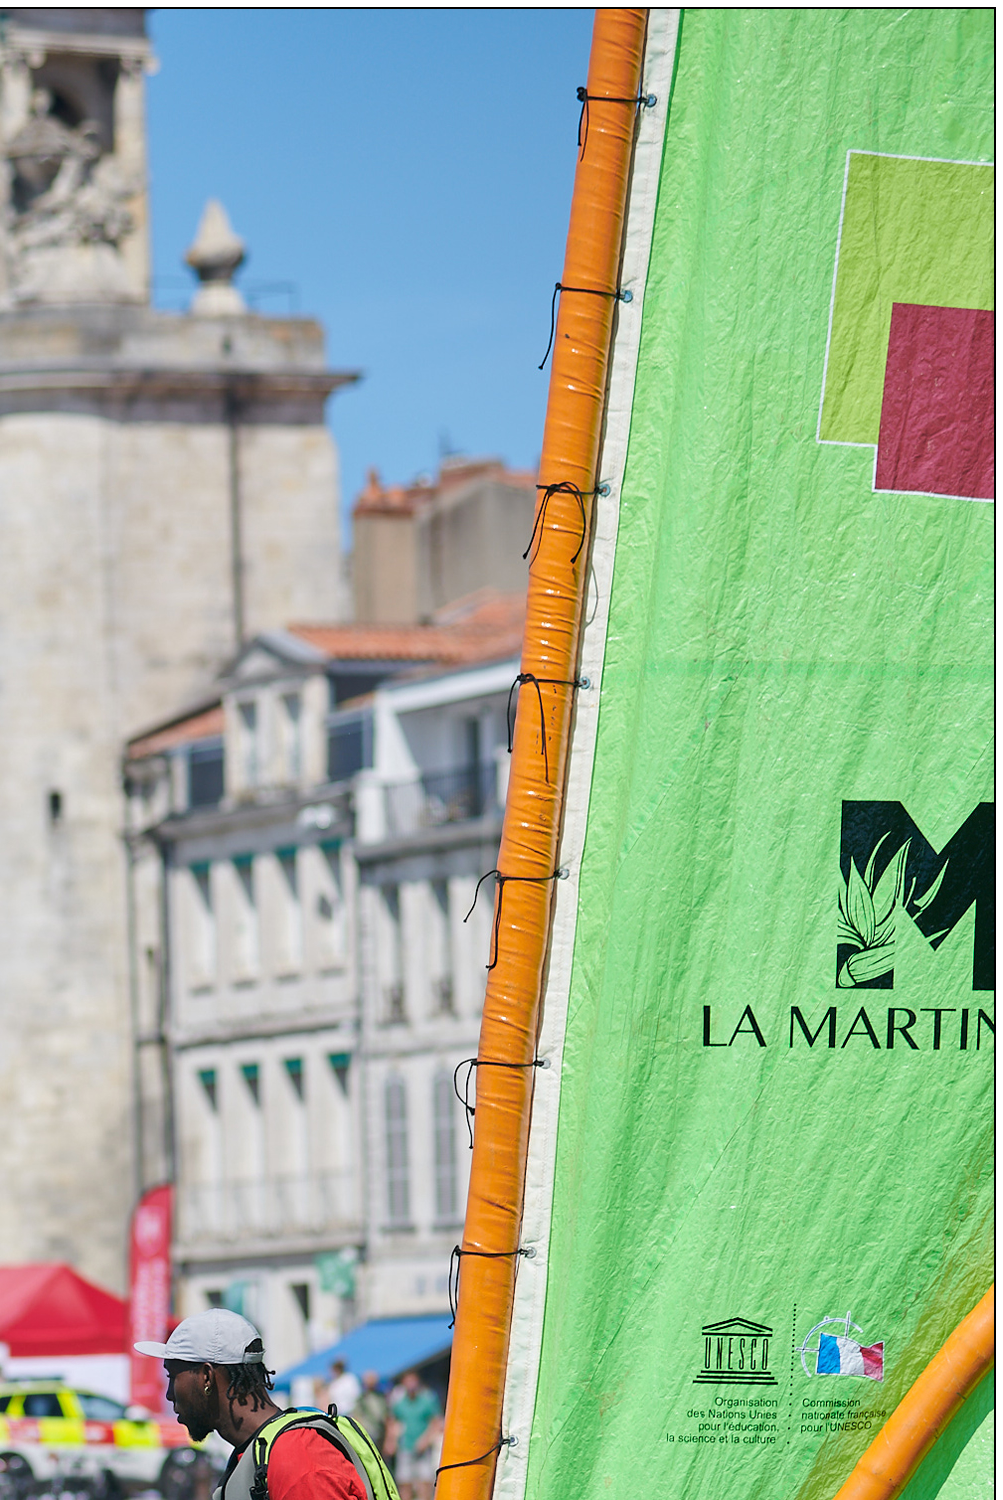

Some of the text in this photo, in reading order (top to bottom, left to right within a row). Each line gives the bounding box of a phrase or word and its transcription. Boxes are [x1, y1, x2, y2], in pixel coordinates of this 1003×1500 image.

[703, 1004, 767, 1048] LA
[704, 1336, 769, 1371] UNESCO
[714, 1396, 778, 1409] Organisation
[802, 1398, 861, 1408] Commission
[686, 1408, 777, 1419] des Nations Unies
[801, 1409, 887, 1420] nationale française
[698, 1421, 780, 1433] pour l'éducation,
[800, 1420, 872, 1434] pour l'UNESCO
[666, 1433, 776, 1444] la science et la culture
